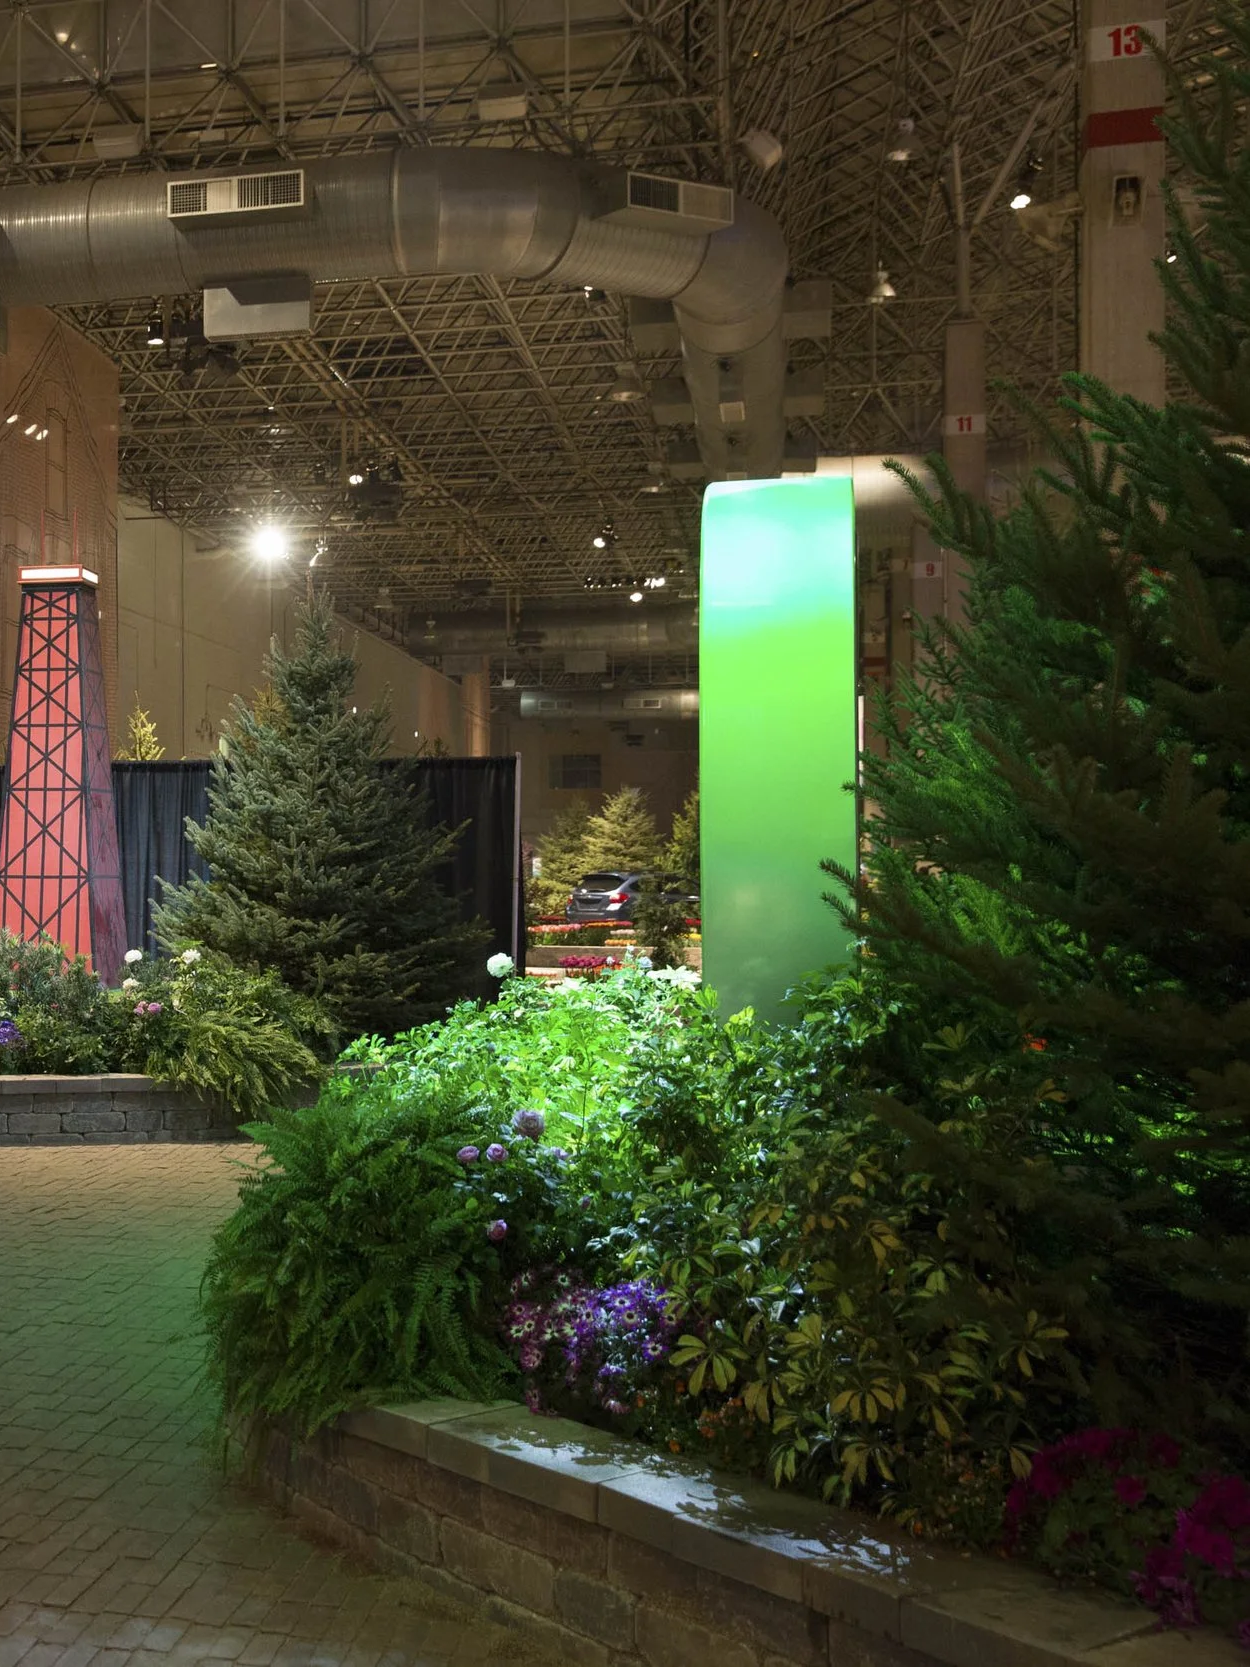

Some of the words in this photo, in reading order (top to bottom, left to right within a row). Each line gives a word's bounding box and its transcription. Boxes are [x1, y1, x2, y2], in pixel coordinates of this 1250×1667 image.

[1107, 24, 1143, 57] 13
[956, 415, 973, 432] 11
[925, 562, 936, 577] 9
